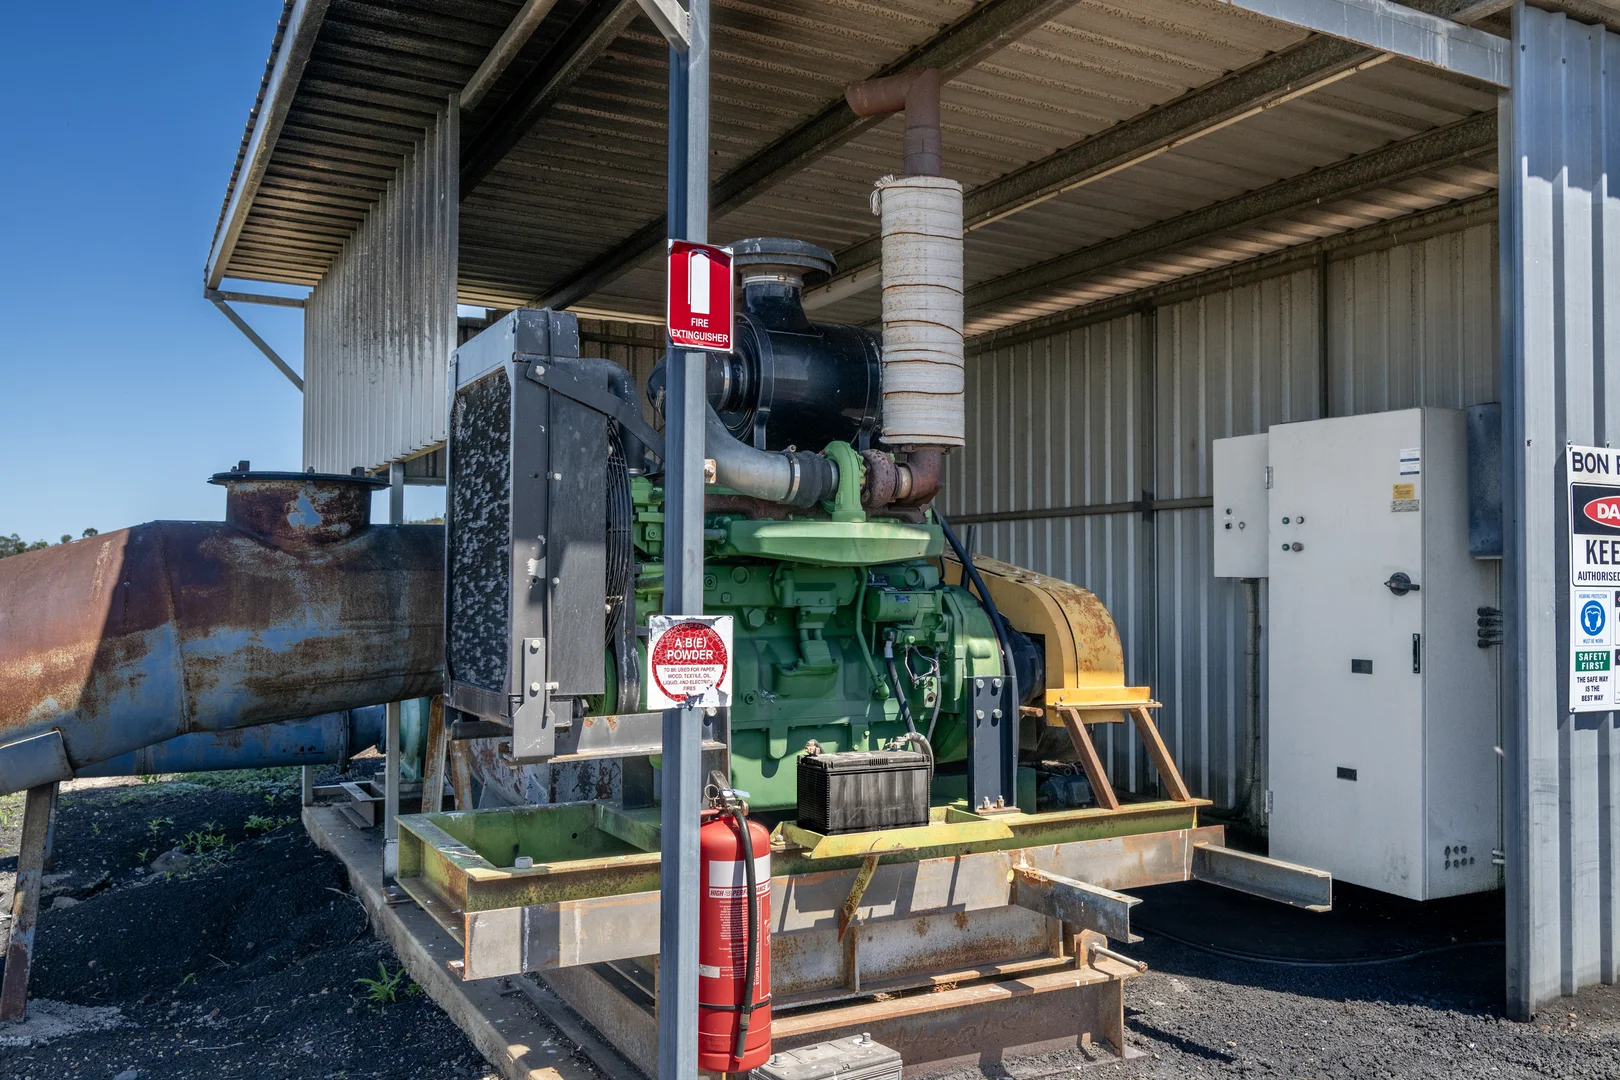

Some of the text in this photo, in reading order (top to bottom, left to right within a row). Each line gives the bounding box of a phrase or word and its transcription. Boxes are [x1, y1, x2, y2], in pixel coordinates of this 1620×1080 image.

[691, 318, 709, 327] FIRE
[671, 328, 729, 343] EXTINGUISHER
[1572, 451, 1609, 474] BON
[667, 650, 714, 660] POWDER
[1578, 652, 1608, 661] SAFETY
[1581, 661, 1605, 670] FIRST
[710, 889, 724, 897] HIGH
